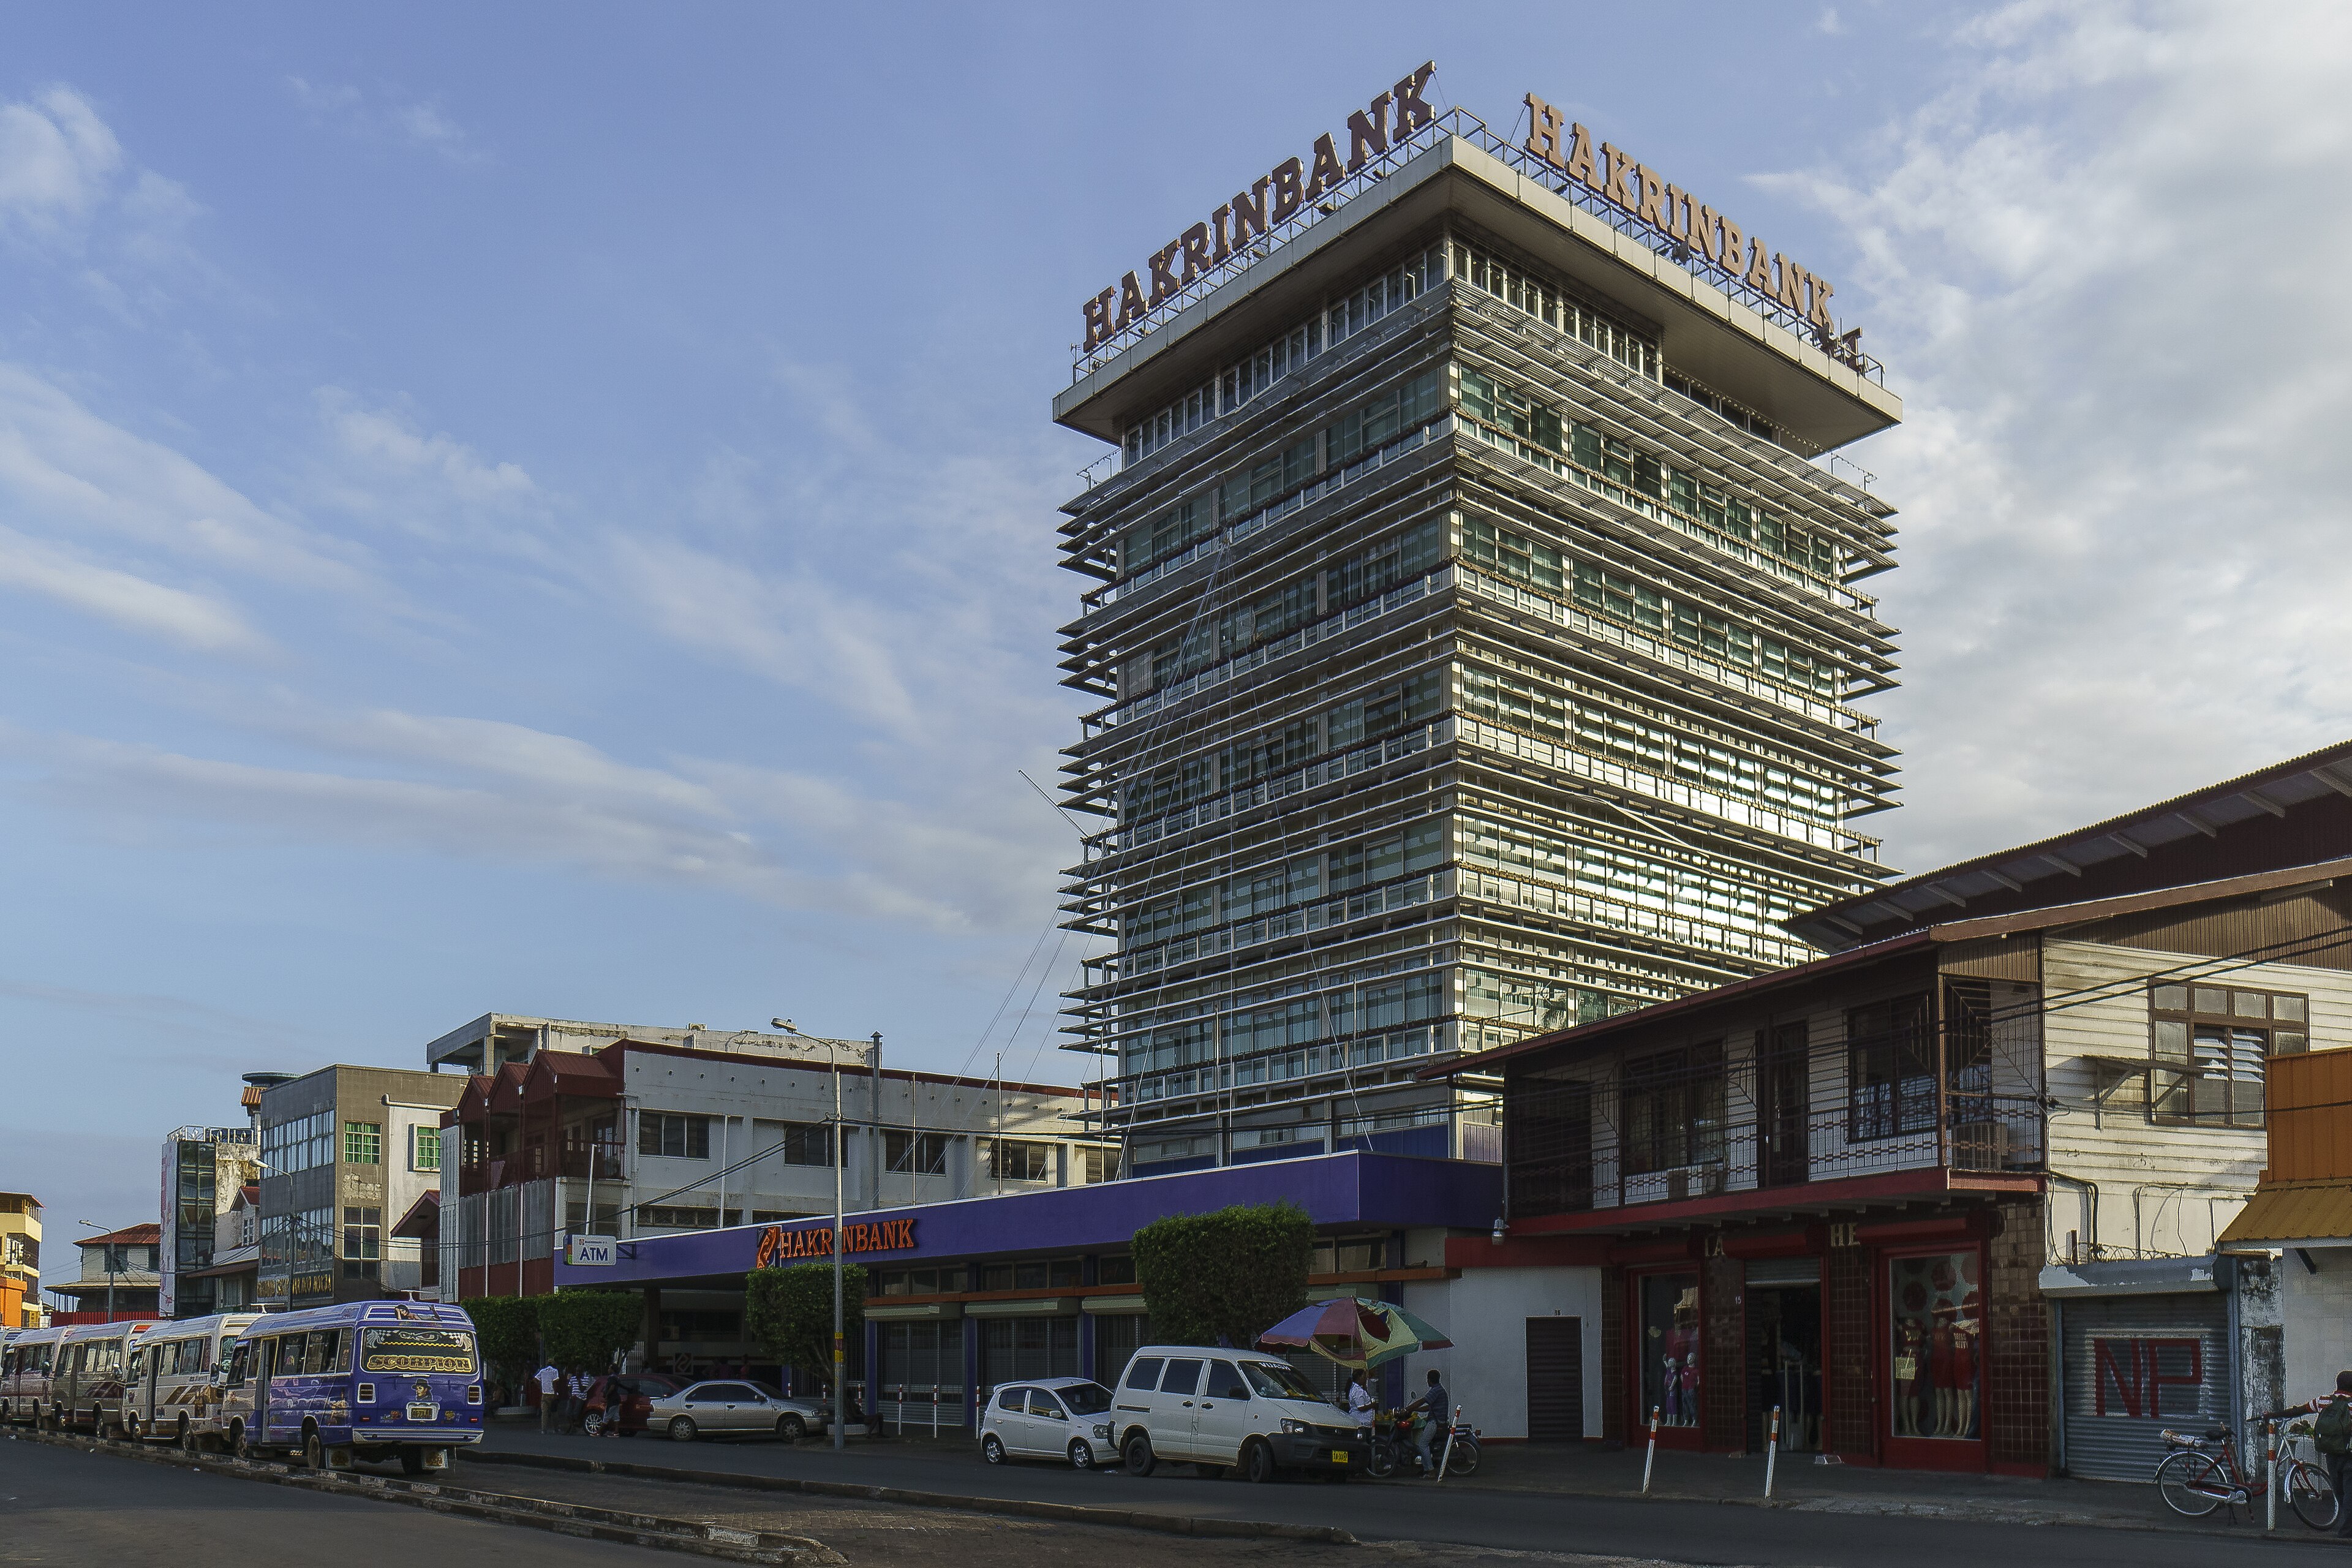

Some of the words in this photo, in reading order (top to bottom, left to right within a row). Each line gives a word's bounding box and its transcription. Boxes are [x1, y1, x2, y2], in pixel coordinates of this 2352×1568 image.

[1083, 60, 1436, 353] HAKRINBANK
[1524, 92, 1834, 336] HAKRINBANK
[579, 1246, 608, 1261] ATM
[780, 1218, 915, 1259] HAKRNBANK
[366, 1354, 473, 1373] SCORPION
[2094, 1338, 2203, 1419] NP
